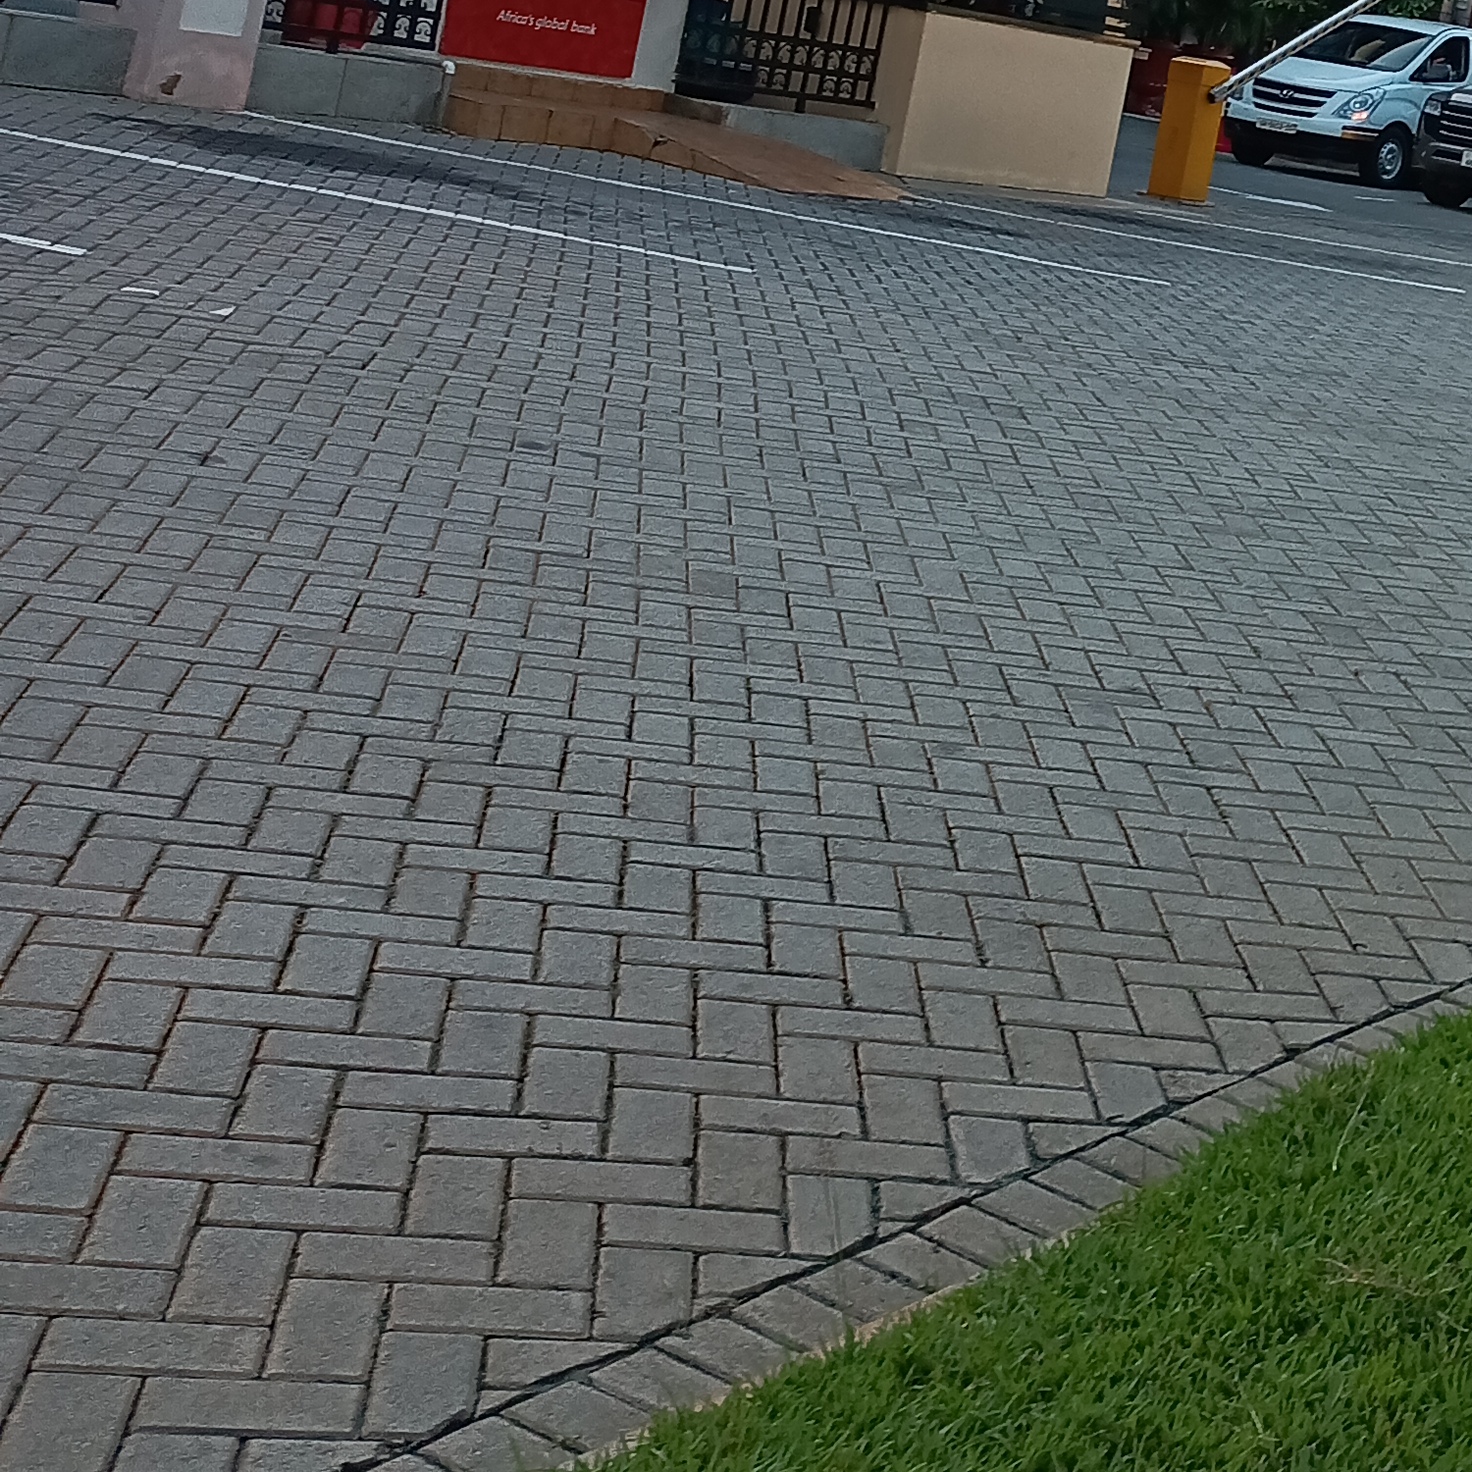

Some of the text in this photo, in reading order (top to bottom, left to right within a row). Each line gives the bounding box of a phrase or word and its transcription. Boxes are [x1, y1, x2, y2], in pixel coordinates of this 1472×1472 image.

[496, 9, 597, 36] Africa's global bank
